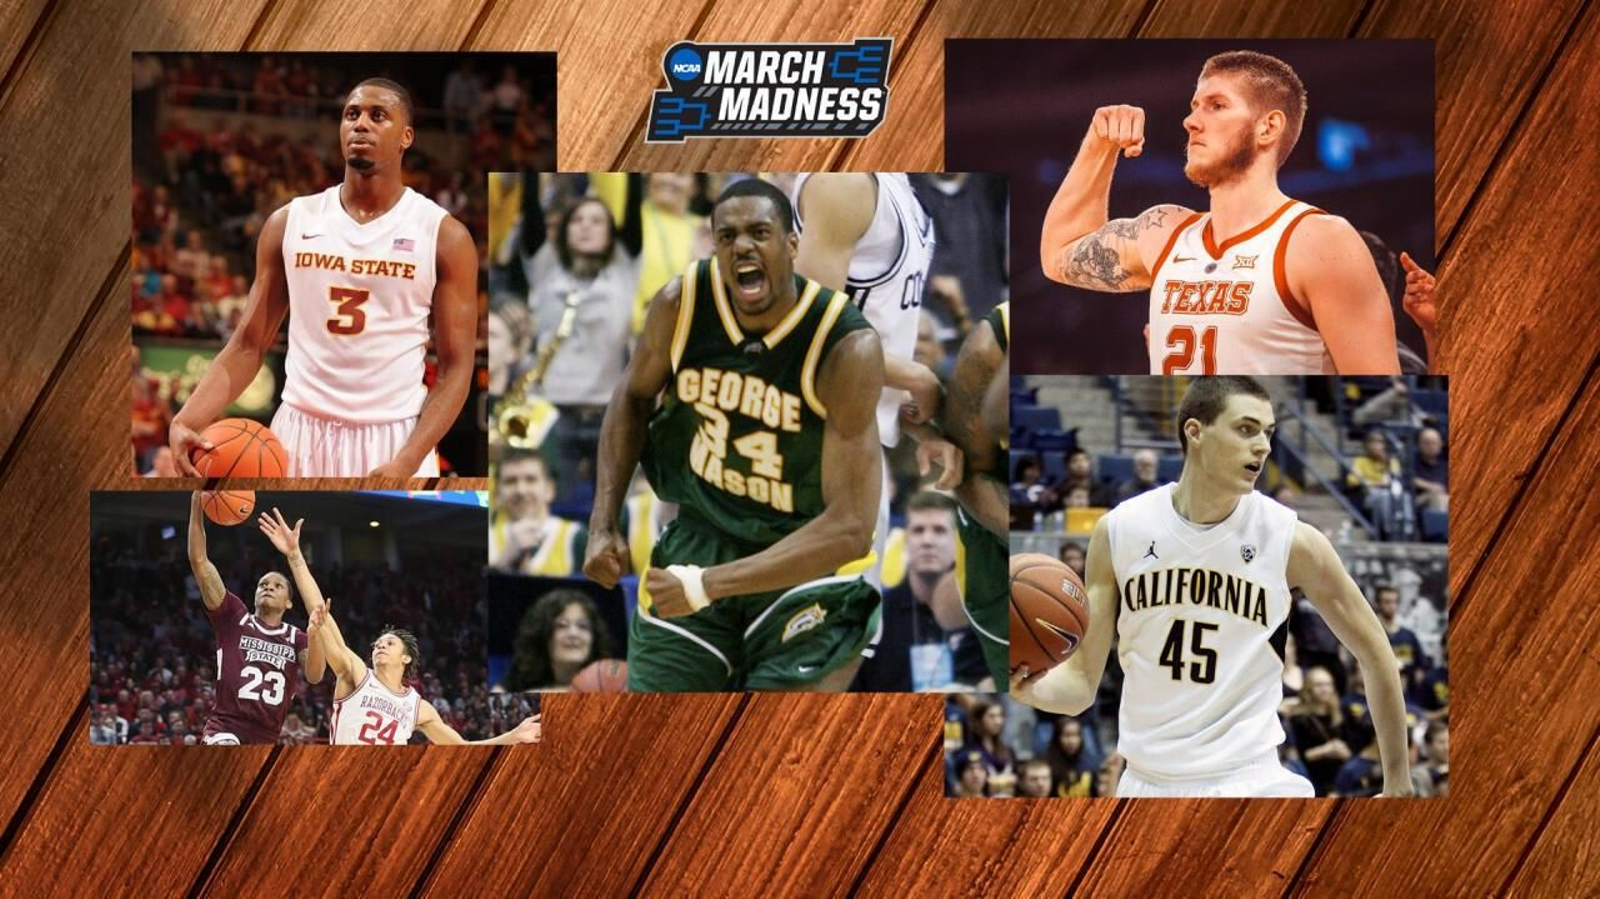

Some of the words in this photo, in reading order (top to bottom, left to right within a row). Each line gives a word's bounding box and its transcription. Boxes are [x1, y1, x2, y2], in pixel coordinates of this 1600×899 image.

[295, 252, 346, 272] IOWA
[351, 259, 416, 280] STATE
[326, 286, 370, 336] 3
[1161, 280, 1254, 316] TEXAS
[1163, 325, 1218, 375] 21
[677, 367, 801, 432] GEORGE
[692, 402, 784, 481] 34
[690, 432, 794, 513] MASON
[1124, 568, 1268, 628] CALIFORNIA
[1159, 619, 1220, 685] 45
[238, 666, 285, 705] 23
[358, 710, 399, 745] 24
